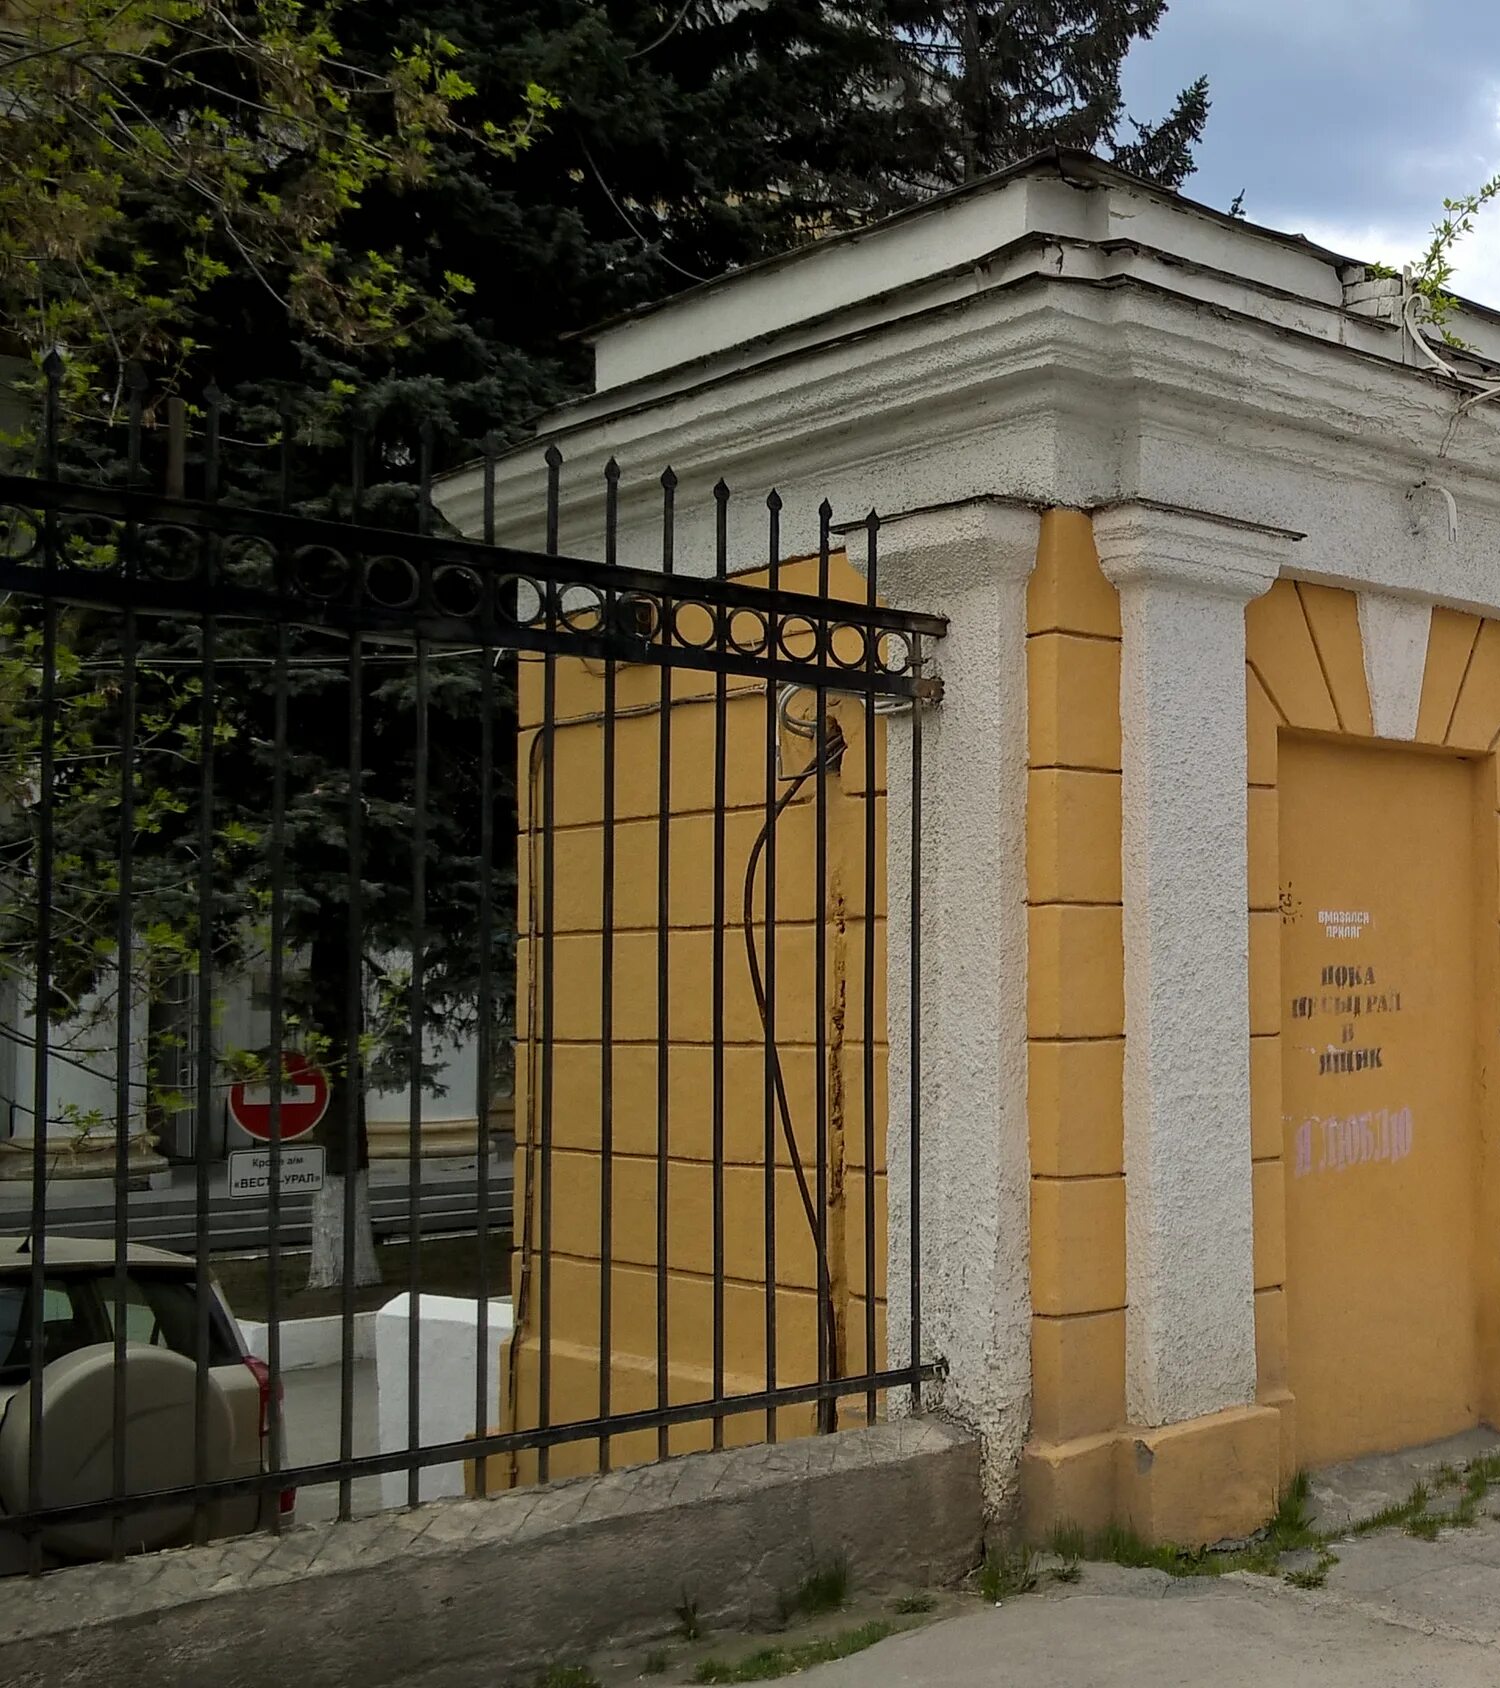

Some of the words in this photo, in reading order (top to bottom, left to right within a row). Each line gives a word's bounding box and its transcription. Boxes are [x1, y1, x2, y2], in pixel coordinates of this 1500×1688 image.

[1326, 926, 1363, 938] ПРИЛЯГ
[1321, 965, 1376, 987] ПОКА
[1342, 1023, 1354, 1044] В
[1318, 1047, 1383, 1076] ЯЩИК
[253, 1158, 284, 1168] Крое
[234, 1173, 320, 1188] «ВЕСТ-УРАЛ»
